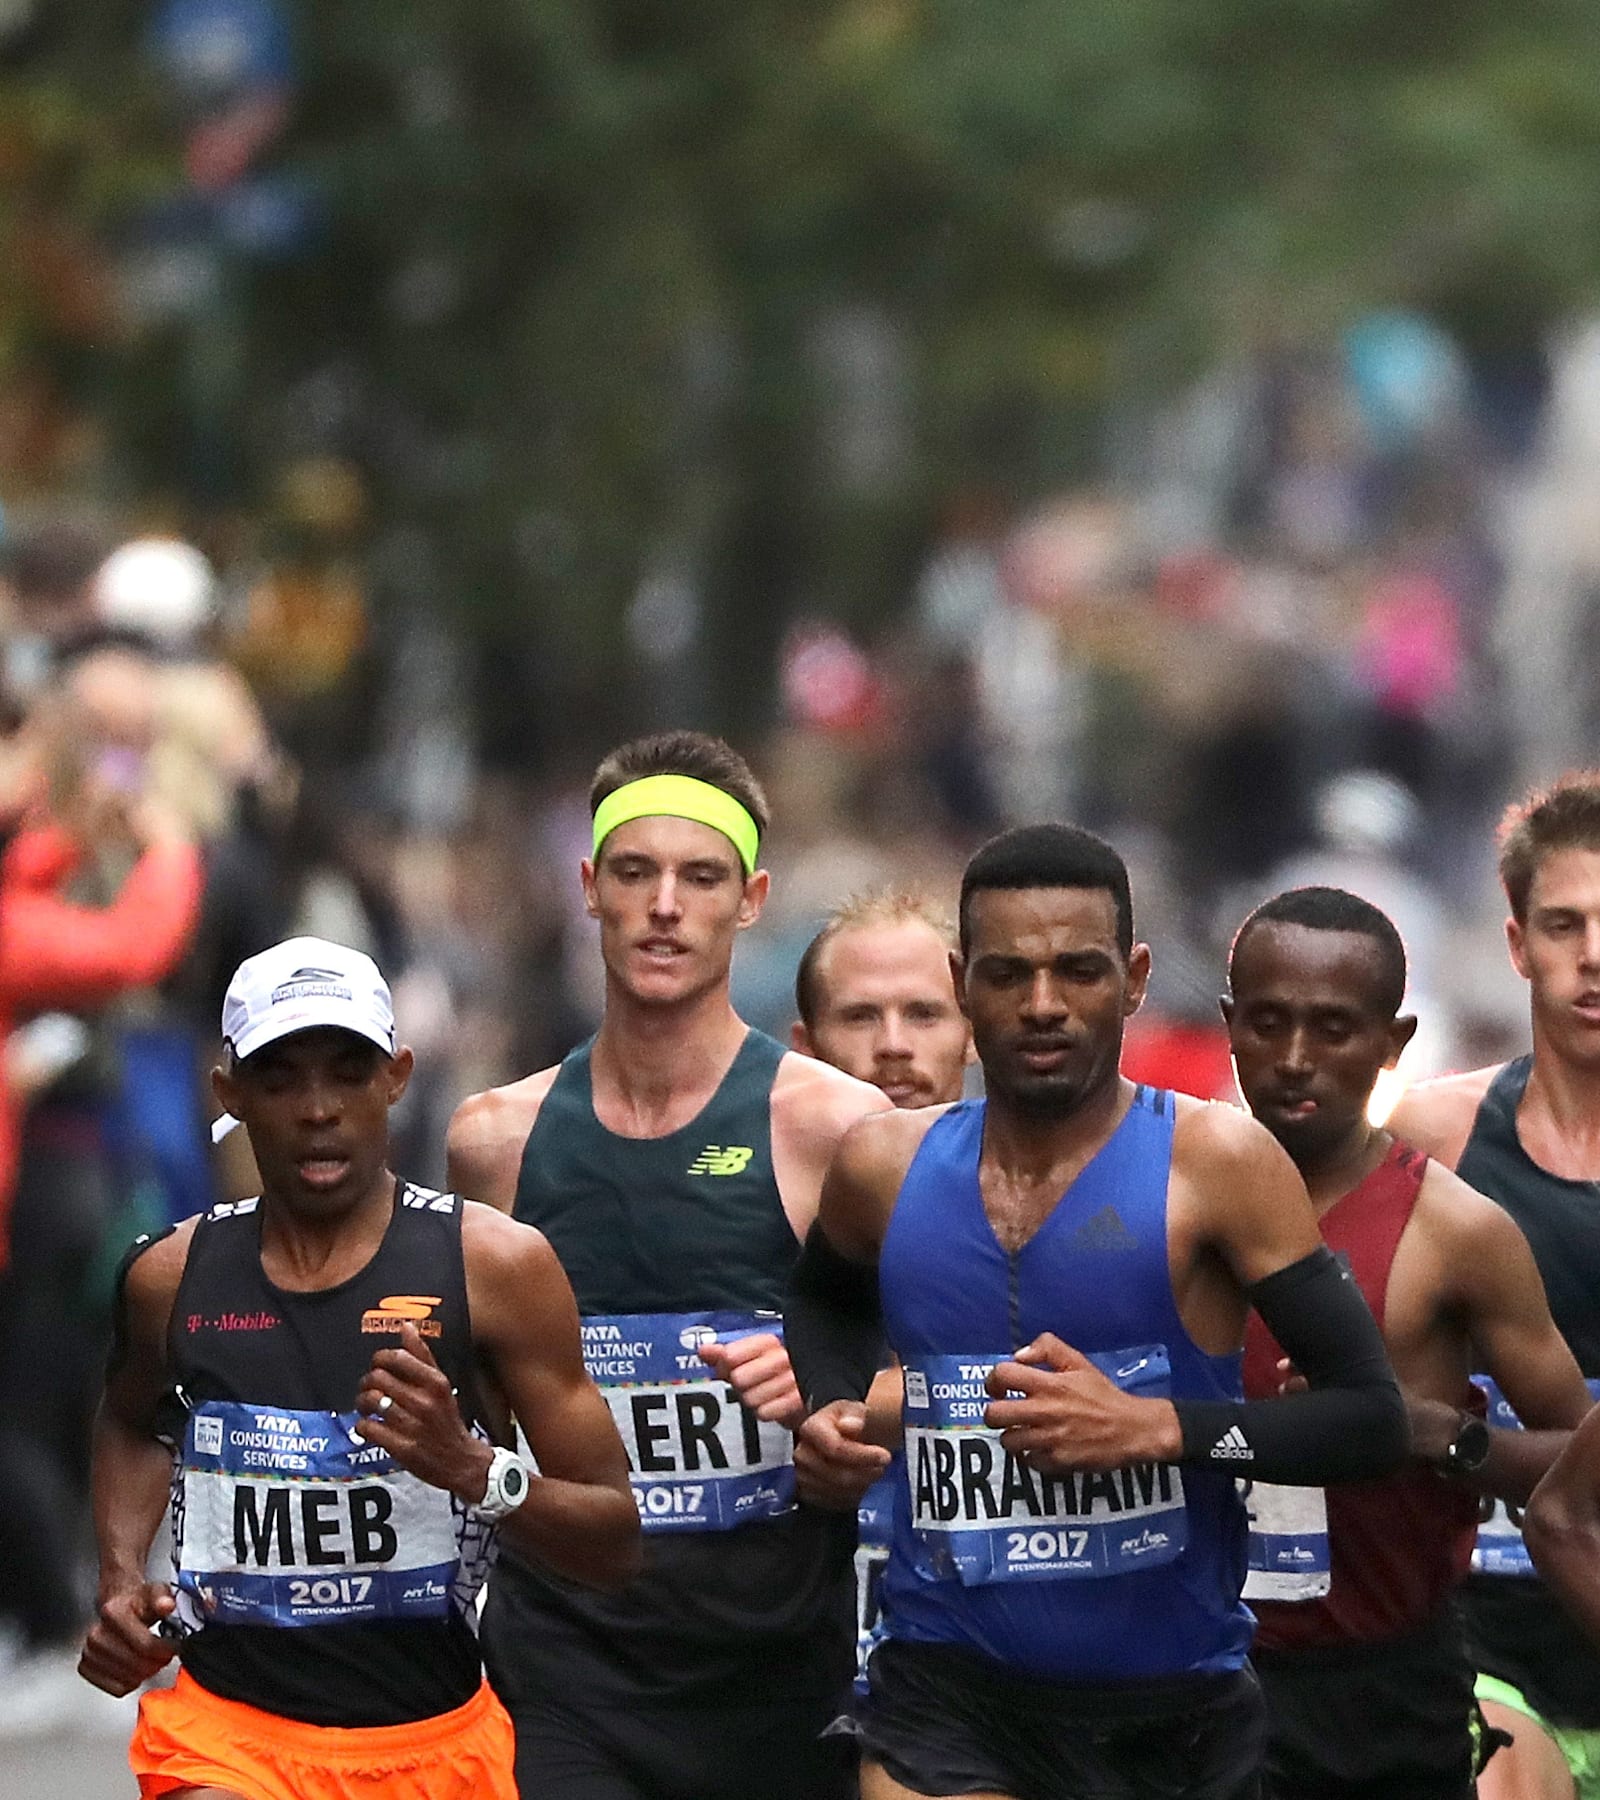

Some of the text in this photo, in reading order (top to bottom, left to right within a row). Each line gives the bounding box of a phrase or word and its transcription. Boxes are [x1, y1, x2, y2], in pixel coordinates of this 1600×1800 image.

[959, 1365, 994, 1380] TAT
[949, 1402, 987, 1418] SERV
[255, 1415, 301, 1433] TATA
[603, 1391, 762, 1472] ERT
[230, 1431, 329, 1452] CONSULTANCY
[243, 1451, 307, 1470] SERVICES
[347, 1447, 391, 1465] TATA
[1210, 1447, 1255, 1460] adidas
[917, 1436, 1173, 1520] ABRAHAM
[233, 1485, 399, 1566] MEB
[1007, 1531, 1089, 1561] 2017
[289, 1576, 373, 1605] 2017
